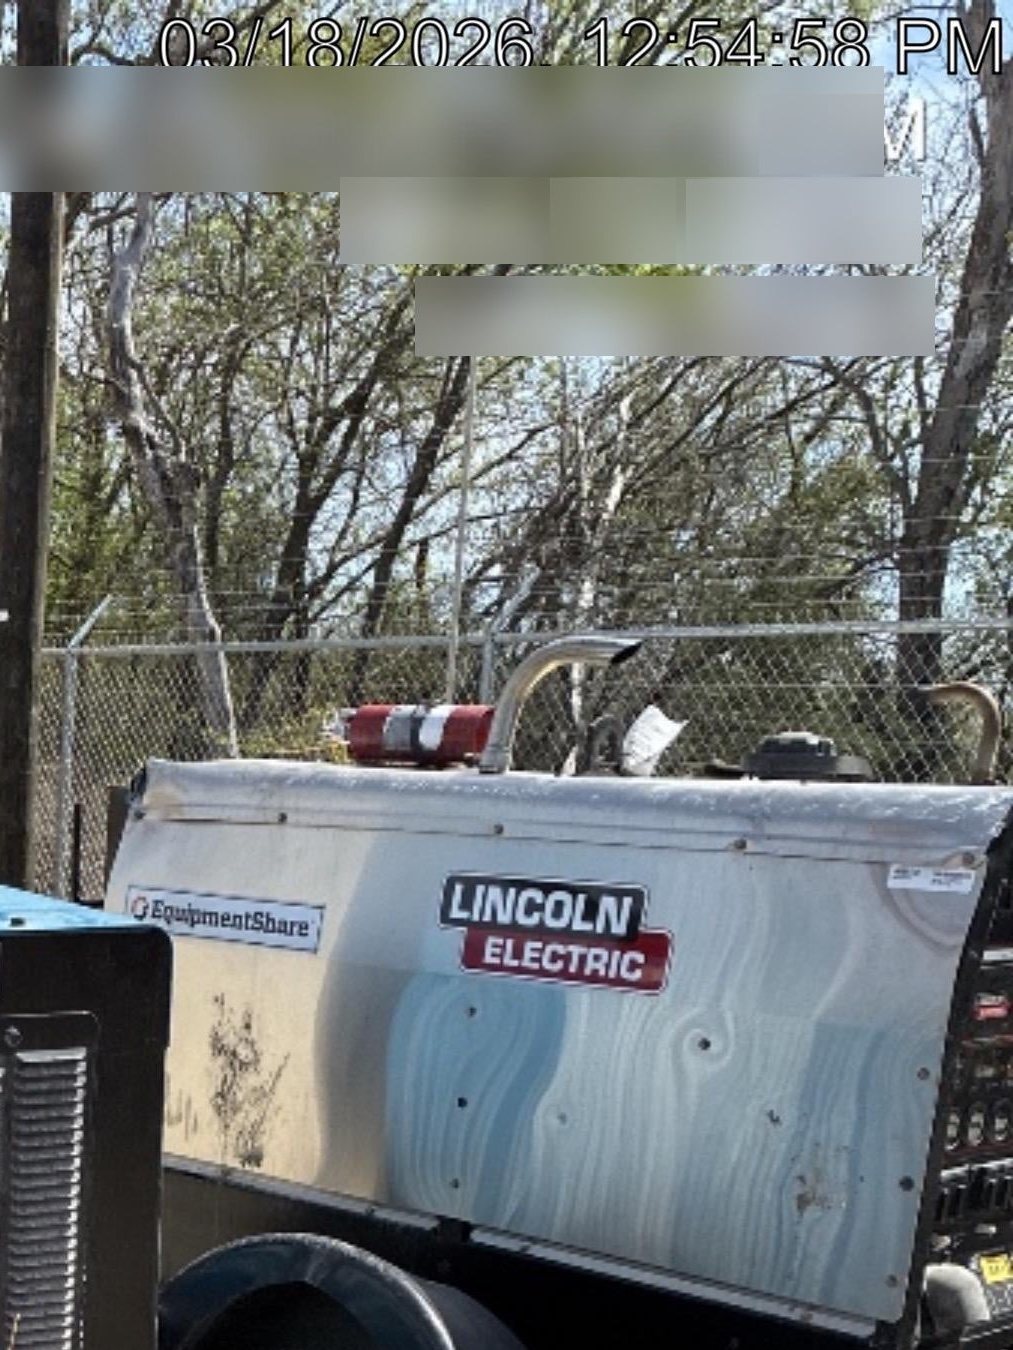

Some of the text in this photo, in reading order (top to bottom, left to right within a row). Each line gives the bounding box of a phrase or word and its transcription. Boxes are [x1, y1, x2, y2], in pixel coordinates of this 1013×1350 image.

[151, 899, 309, 937] EquipmentShare
[448, 883, 633, 936] LINCOLN
[482, 936, 646, 982] ELECTRIC
